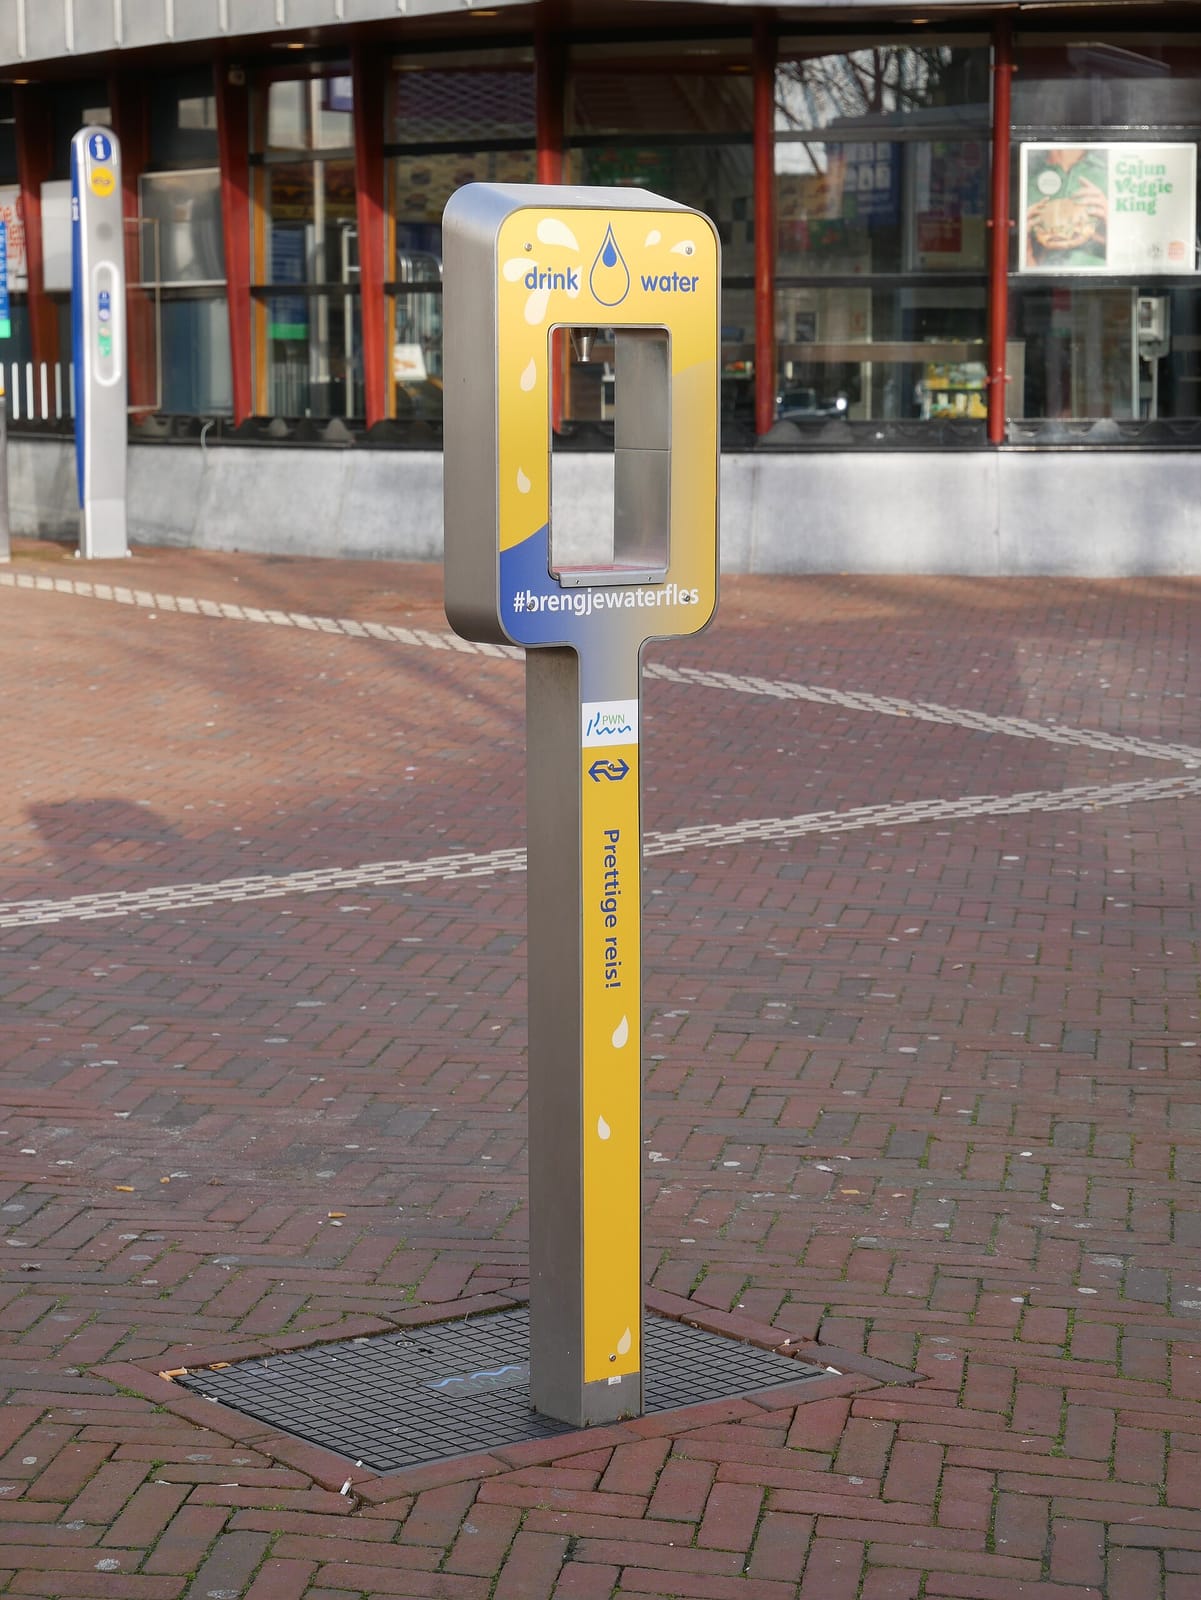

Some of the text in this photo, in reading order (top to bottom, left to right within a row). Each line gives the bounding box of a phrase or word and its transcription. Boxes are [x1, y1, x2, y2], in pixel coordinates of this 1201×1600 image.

[1115, 161, 1166, 179] Cajun
[1115, 179, 1173, 196] Veggie
[1116, 198, 1157, 215] King
[524, 266, 699, 292] drink water
[513, 583, 699, 616] #brengjewaterfles
[602, 714, 625, 725] PWN
[600, 829, 622, 989] Prettige reis!
